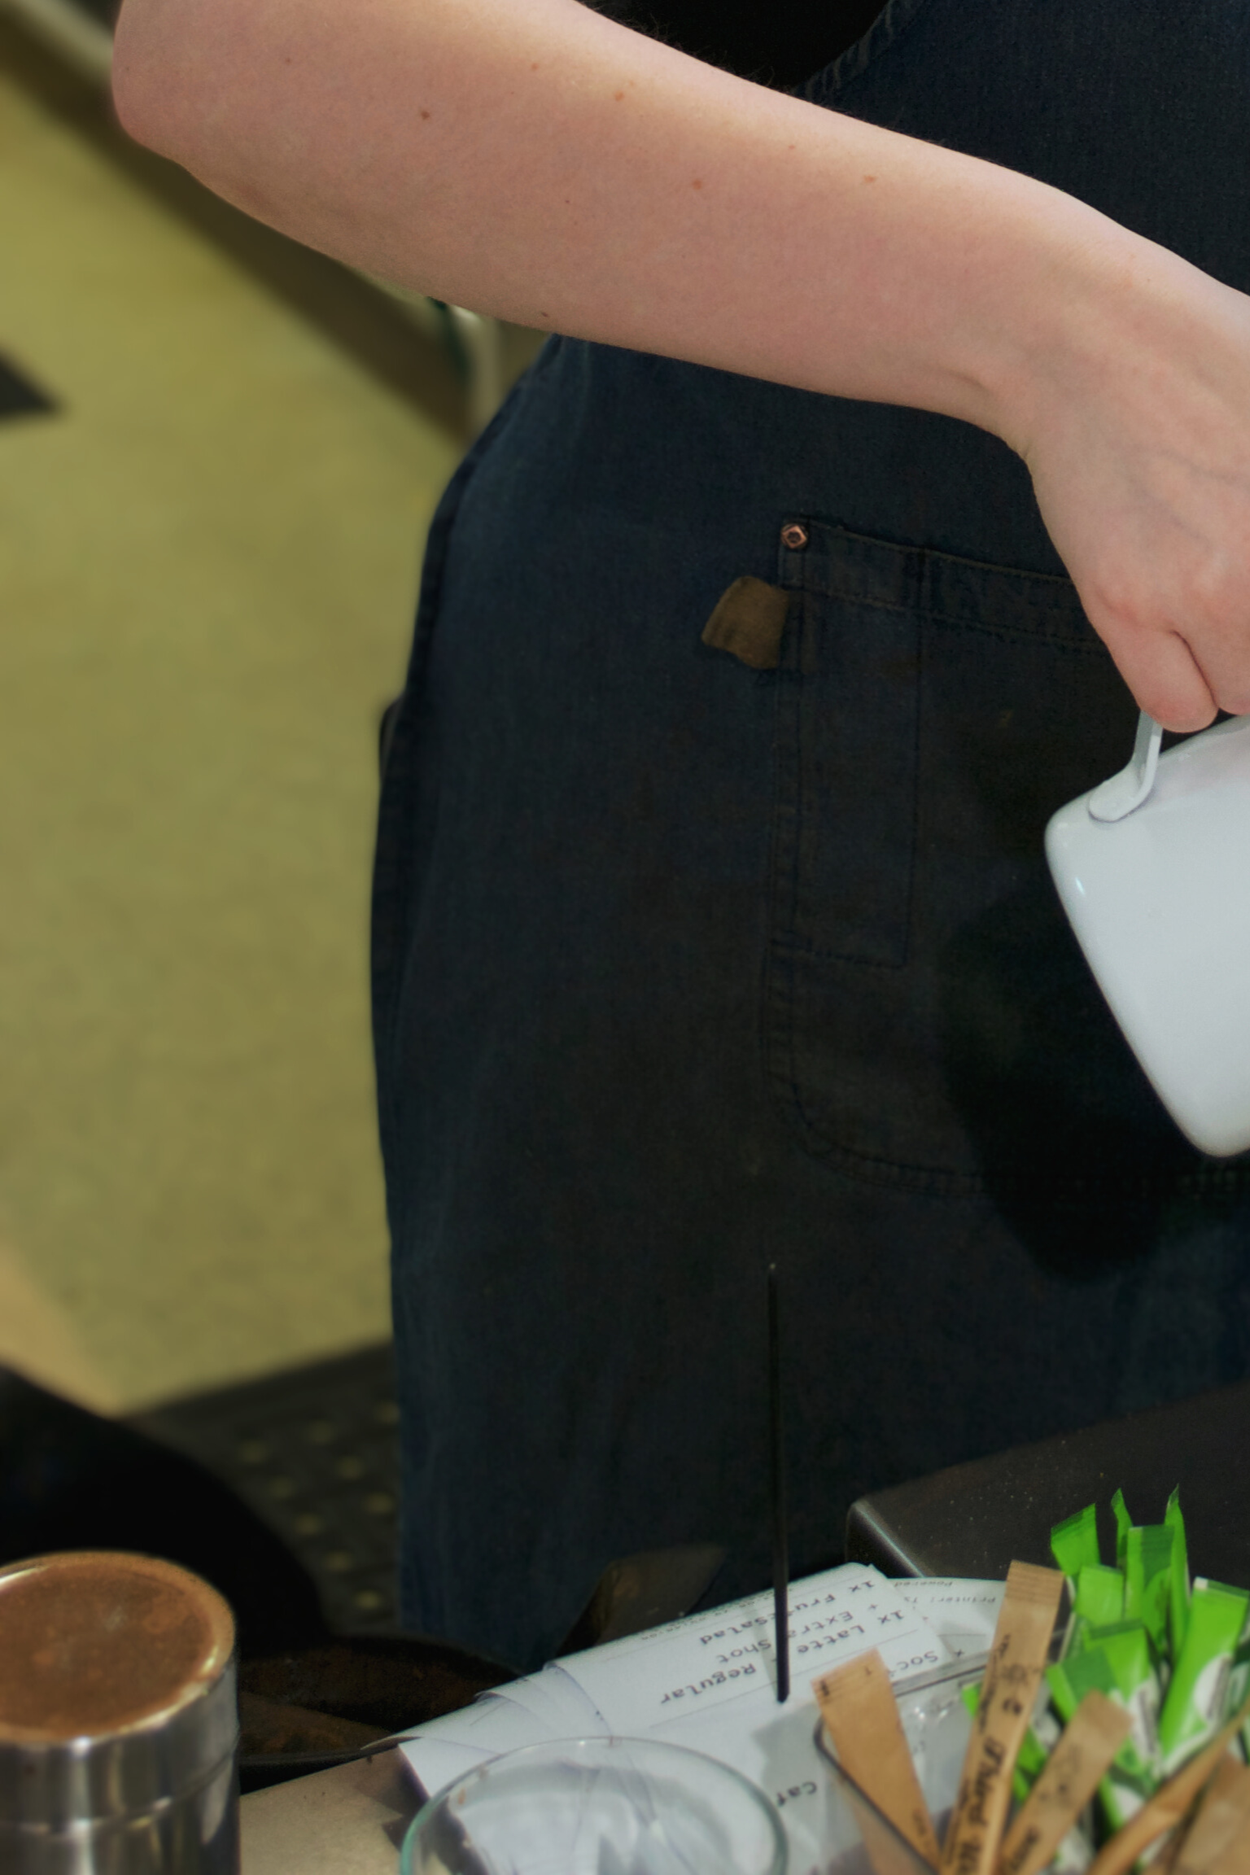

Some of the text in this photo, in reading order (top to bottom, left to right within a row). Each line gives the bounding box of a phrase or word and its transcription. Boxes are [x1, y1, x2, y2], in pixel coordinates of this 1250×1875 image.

[848, 1580, 875, 1593] 1x
[787, 1610, 853, 1639] Extra
[877, 1609, 905, 1625] 1x
[716, 1639, 771, 1664] Shot
[797, 1624, 865, 1654] Latte
[660, 1663, 757, 1704] Regular
